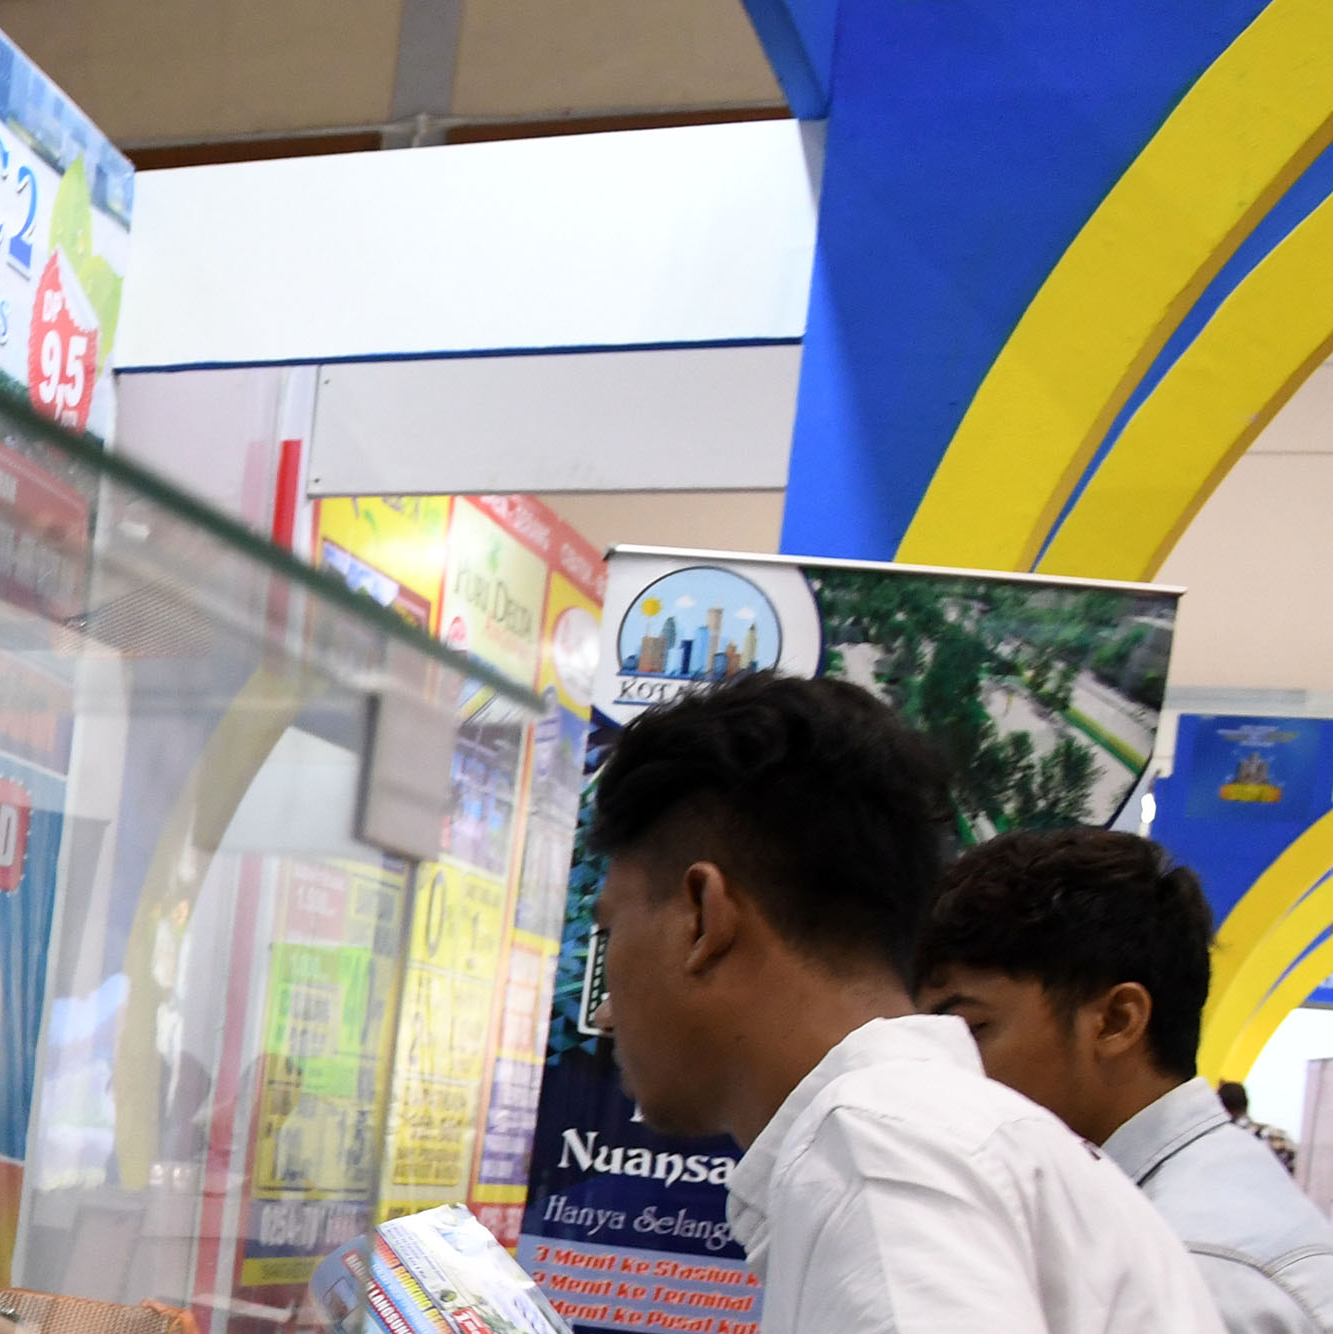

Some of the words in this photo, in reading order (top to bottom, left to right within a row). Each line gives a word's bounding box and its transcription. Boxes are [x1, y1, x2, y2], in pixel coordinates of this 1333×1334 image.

[556, 1127, 737, 1190] Nuansa
[543, 1194, 627, 1237] Hanya
[632, 1205, 733, 1251] Selang
[534, 1245, 550, 1263] 3
[553, 1248, 618, 1272] Menit
[652, 1260, 744, 1285] Stasiun
[549, 1273, 614, 1297] Menit
[652, 1285, 755, 1312] Terminal
[644, 1310, 715, 1333] Pusat
